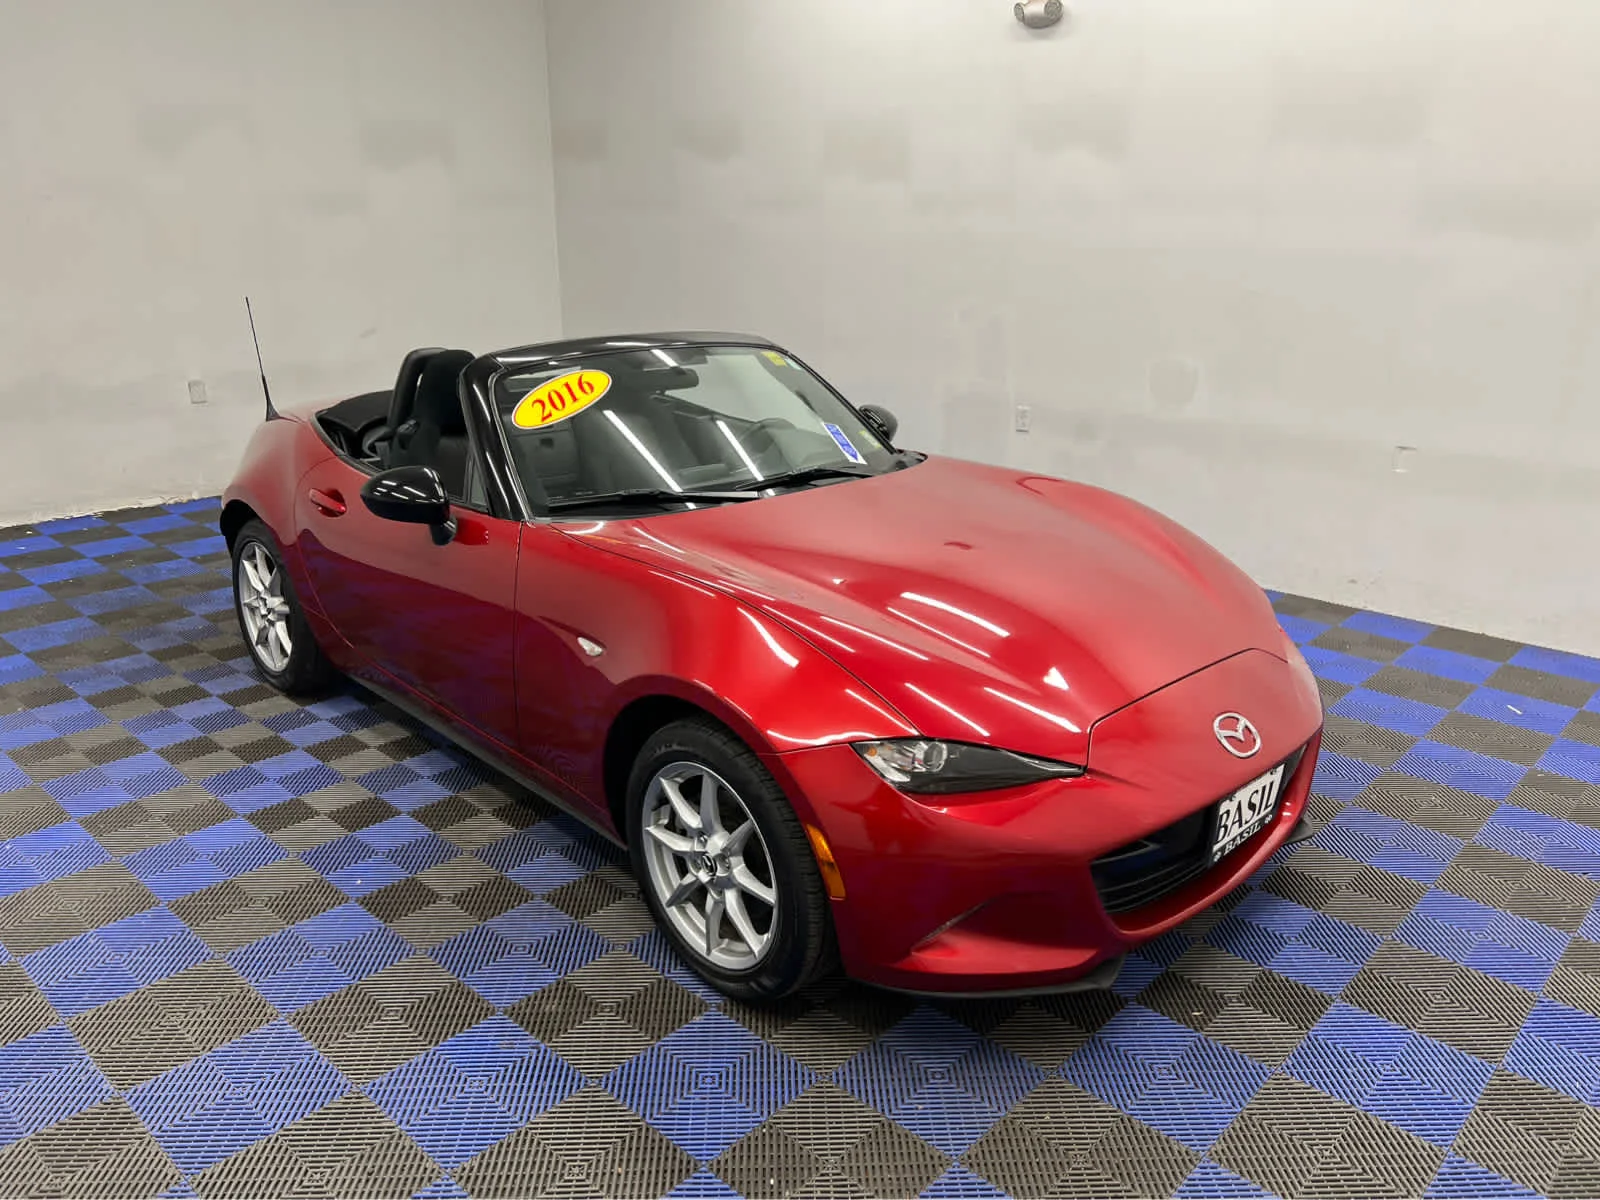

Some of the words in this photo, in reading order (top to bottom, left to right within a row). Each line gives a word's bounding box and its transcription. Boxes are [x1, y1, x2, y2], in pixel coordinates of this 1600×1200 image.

[532, 374, 594, 421] 2016
[1217, 780, 1274, 842] BASIL
[1223, 821, 1261, 856] BASIL
